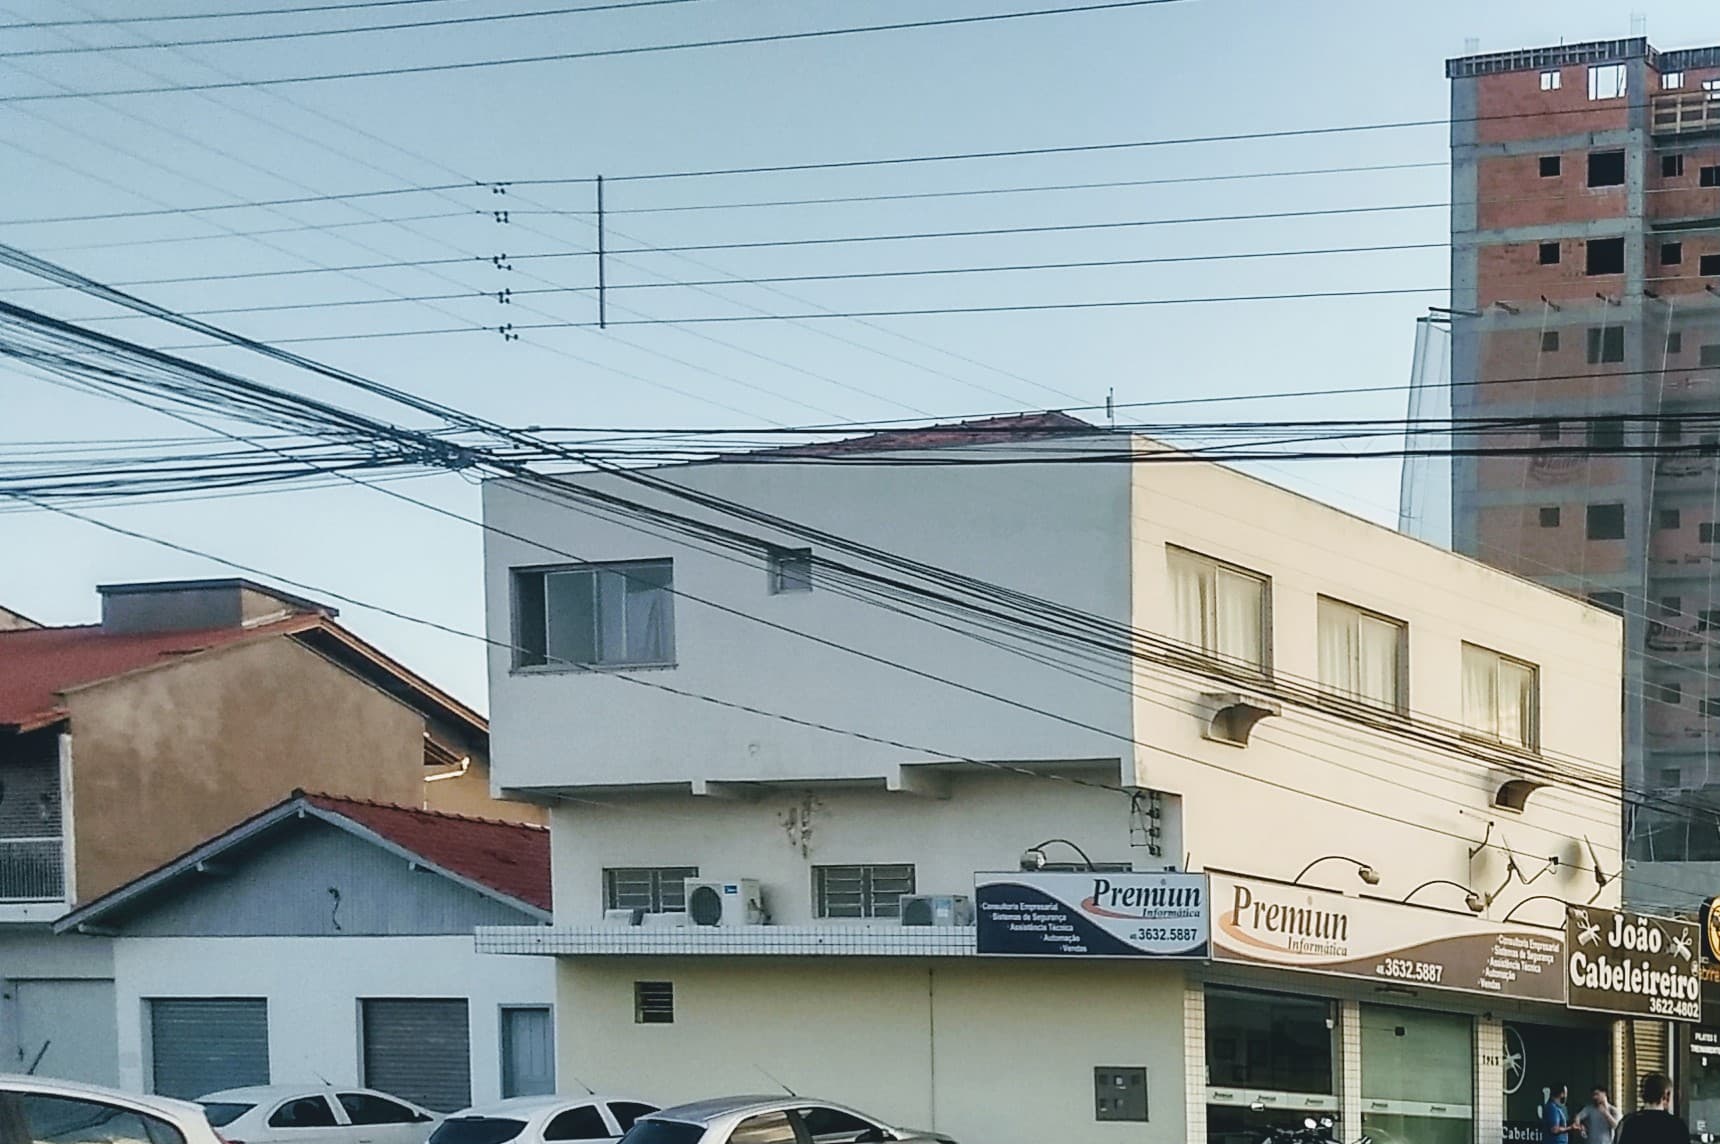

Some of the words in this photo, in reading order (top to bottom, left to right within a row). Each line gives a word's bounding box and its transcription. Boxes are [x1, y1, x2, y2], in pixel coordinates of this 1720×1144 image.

[1093, 878, 1200, 907] Premiun
[1143, 907, 1200, 918] Informática
[1232, 885, 1349, 942] Premiun
[1608, 914, 1662, 953] João
[1288, 936, 1348, 957] Informática
[1570, 951, 1699, 1001] Cabeleireiro
[1650, 998, 1699, 1017] 3622-4802
[1503, 1126, 1543, 1142] Cabelei
